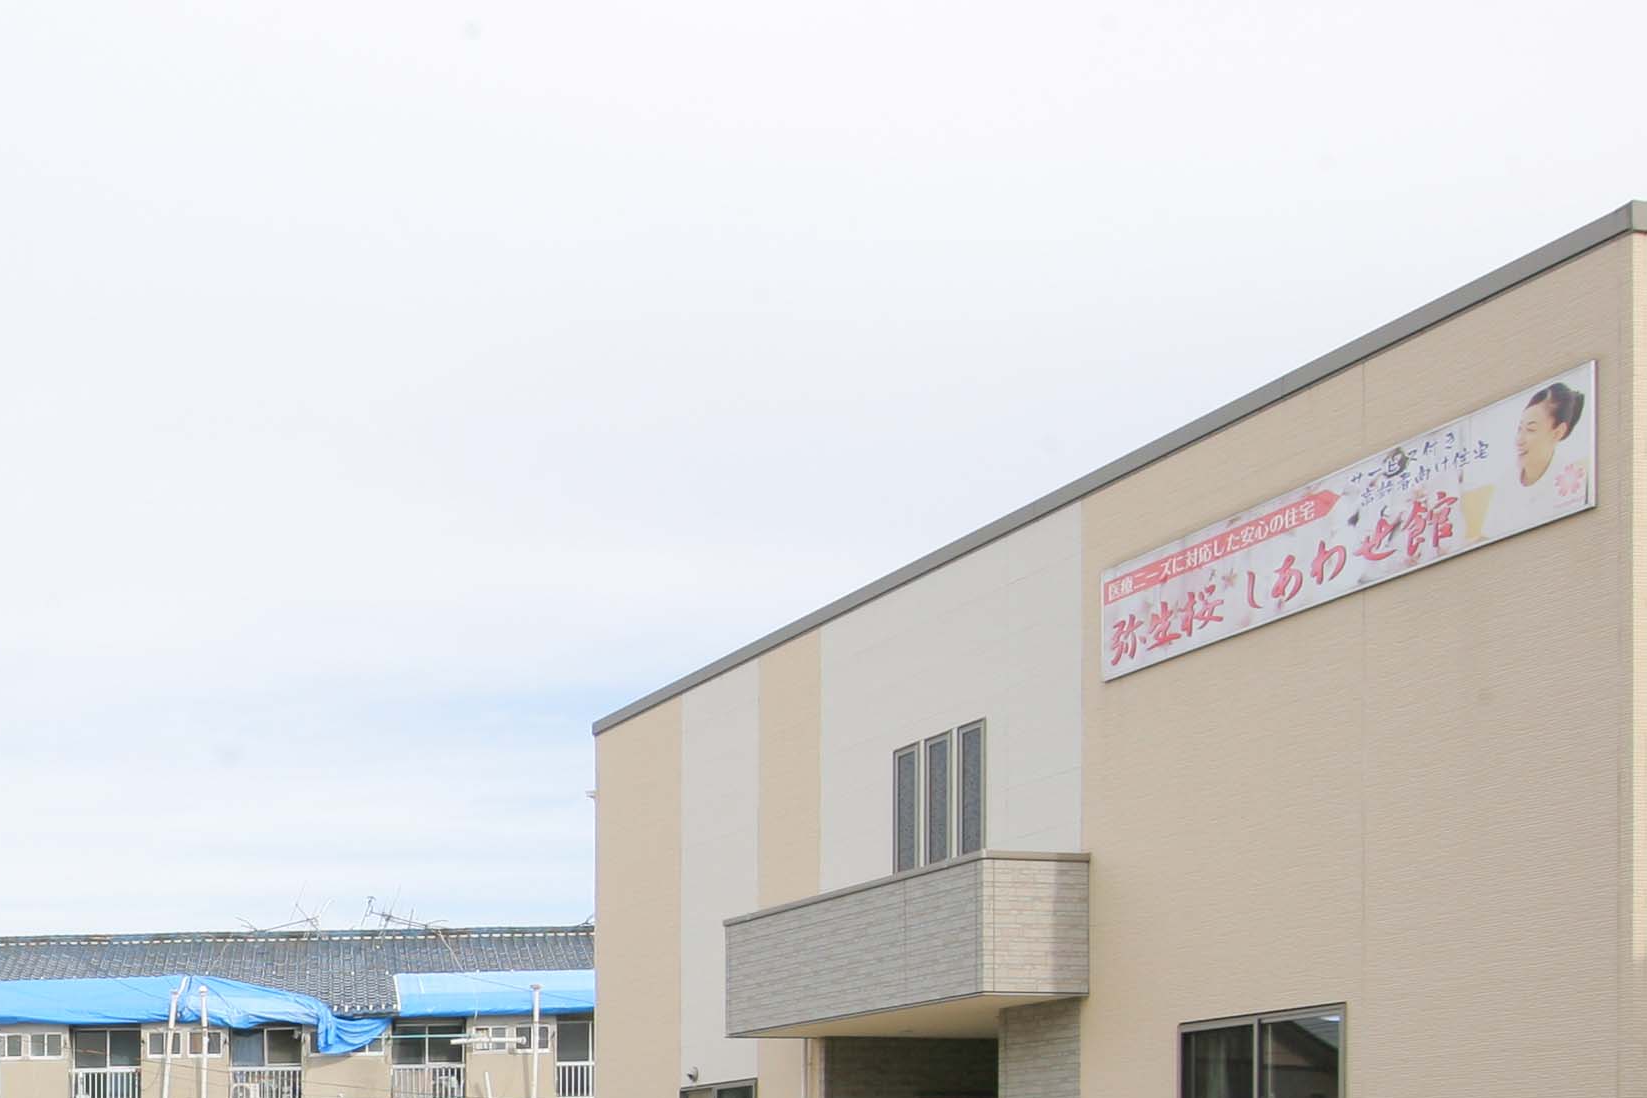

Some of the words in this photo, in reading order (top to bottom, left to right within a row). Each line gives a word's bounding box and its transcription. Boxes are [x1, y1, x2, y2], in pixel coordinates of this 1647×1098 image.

[1108, 502, 1315, 601] 医療ニーズに対応した安心の住宅
